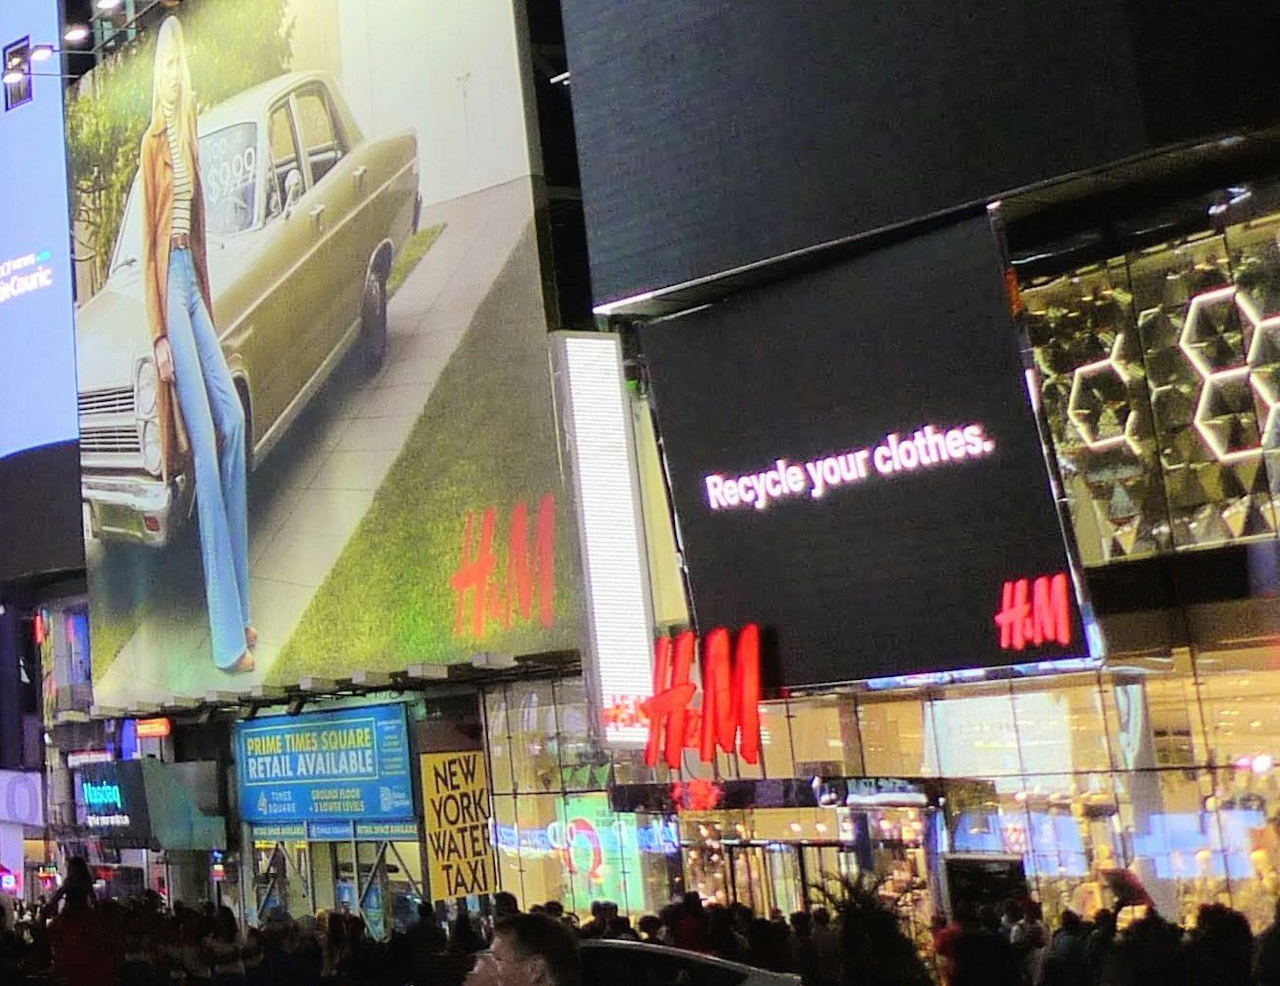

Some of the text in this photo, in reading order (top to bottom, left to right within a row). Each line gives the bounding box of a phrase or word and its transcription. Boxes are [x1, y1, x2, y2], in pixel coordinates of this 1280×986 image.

[705, 422, 996, 511] Recycle your clothes.
[451, 496, 556, 640] H&M
[995, 572, 1071, 651] H&M
[642, 623, 761, 770] H&M
[247, 728, 371, 756] PRIME TIMES SQUARE
[248, 750, 373, 779] RETAIL AVAILABLE
[433, 754, 476, 794] NEW
[83, 780, 121, 809] Nasdaq
[271, 791, 292, 801] TIMES
[430, 788, 490, 829] YORK
[441, 859, 489, 896] TAXI
